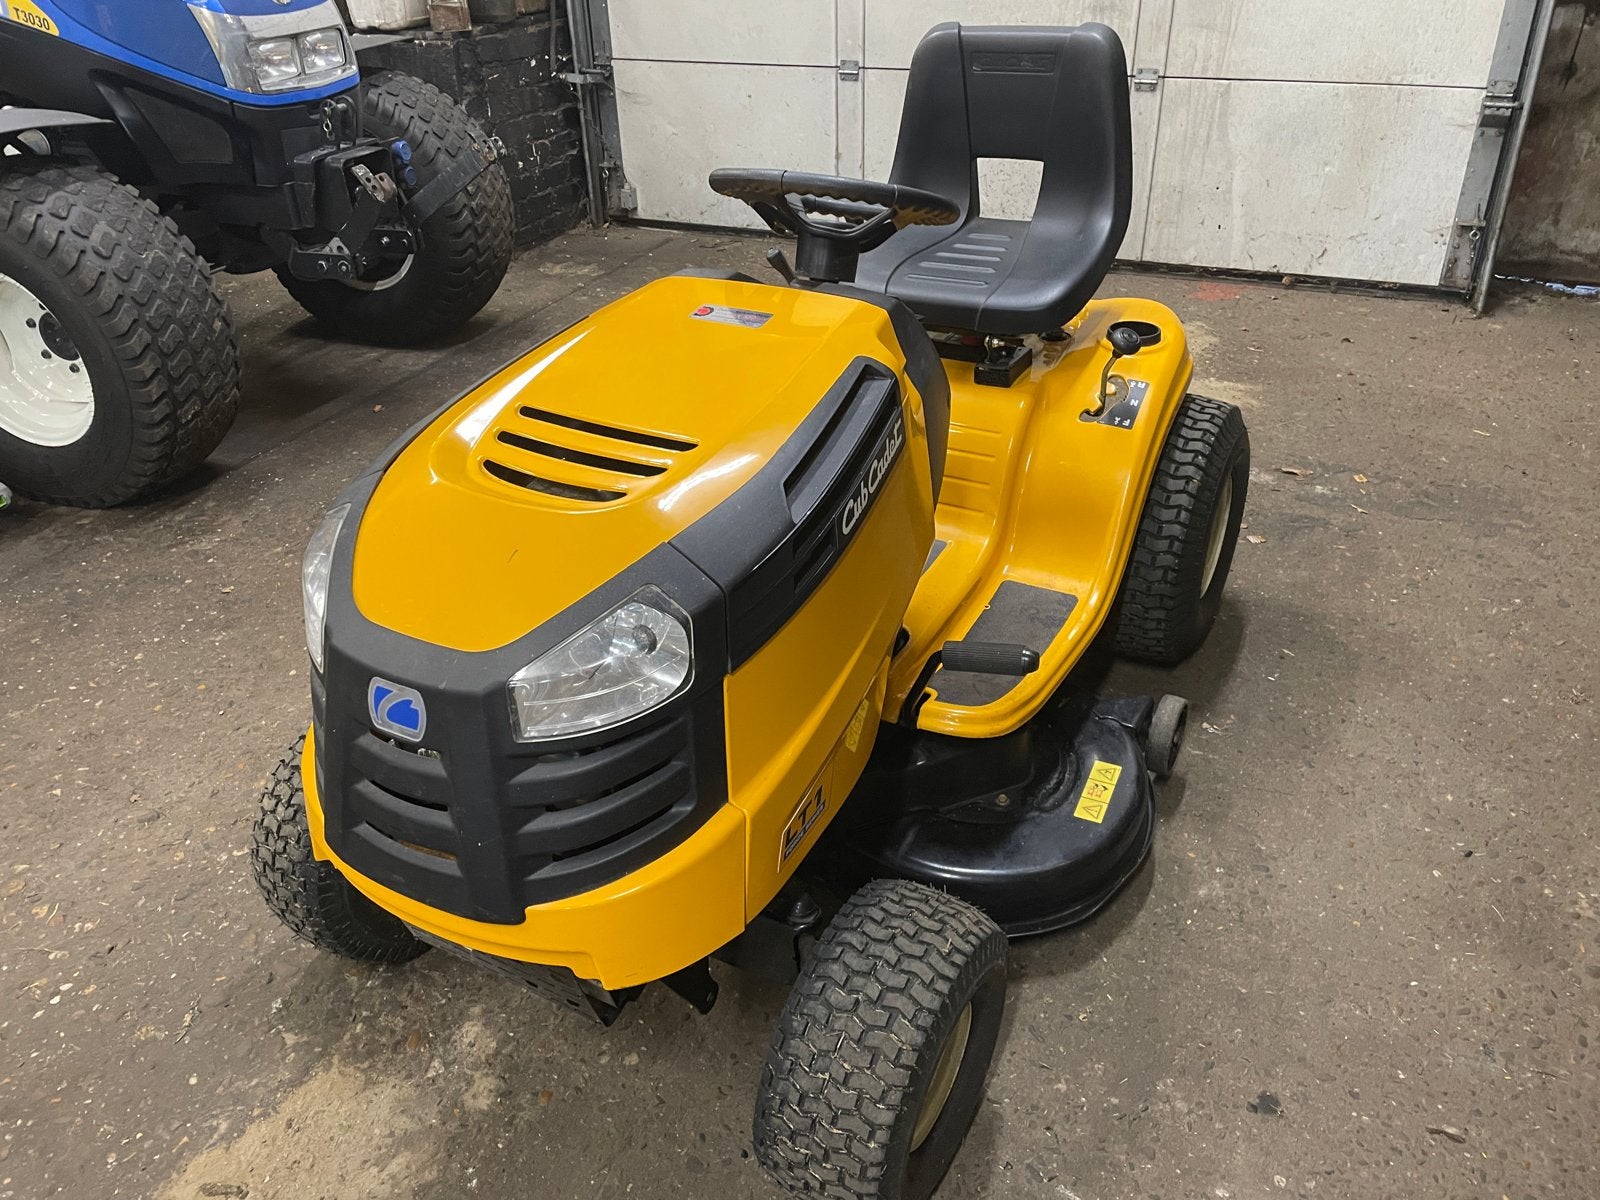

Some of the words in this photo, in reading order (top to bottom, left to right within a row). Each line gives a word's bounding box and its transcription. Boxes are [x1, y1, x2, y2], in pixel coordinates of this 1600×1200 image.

[12, 6, 50, 31] T3030
[842, 480, 869, 535] Cub
[868, 417, 902, 494] Cadet
